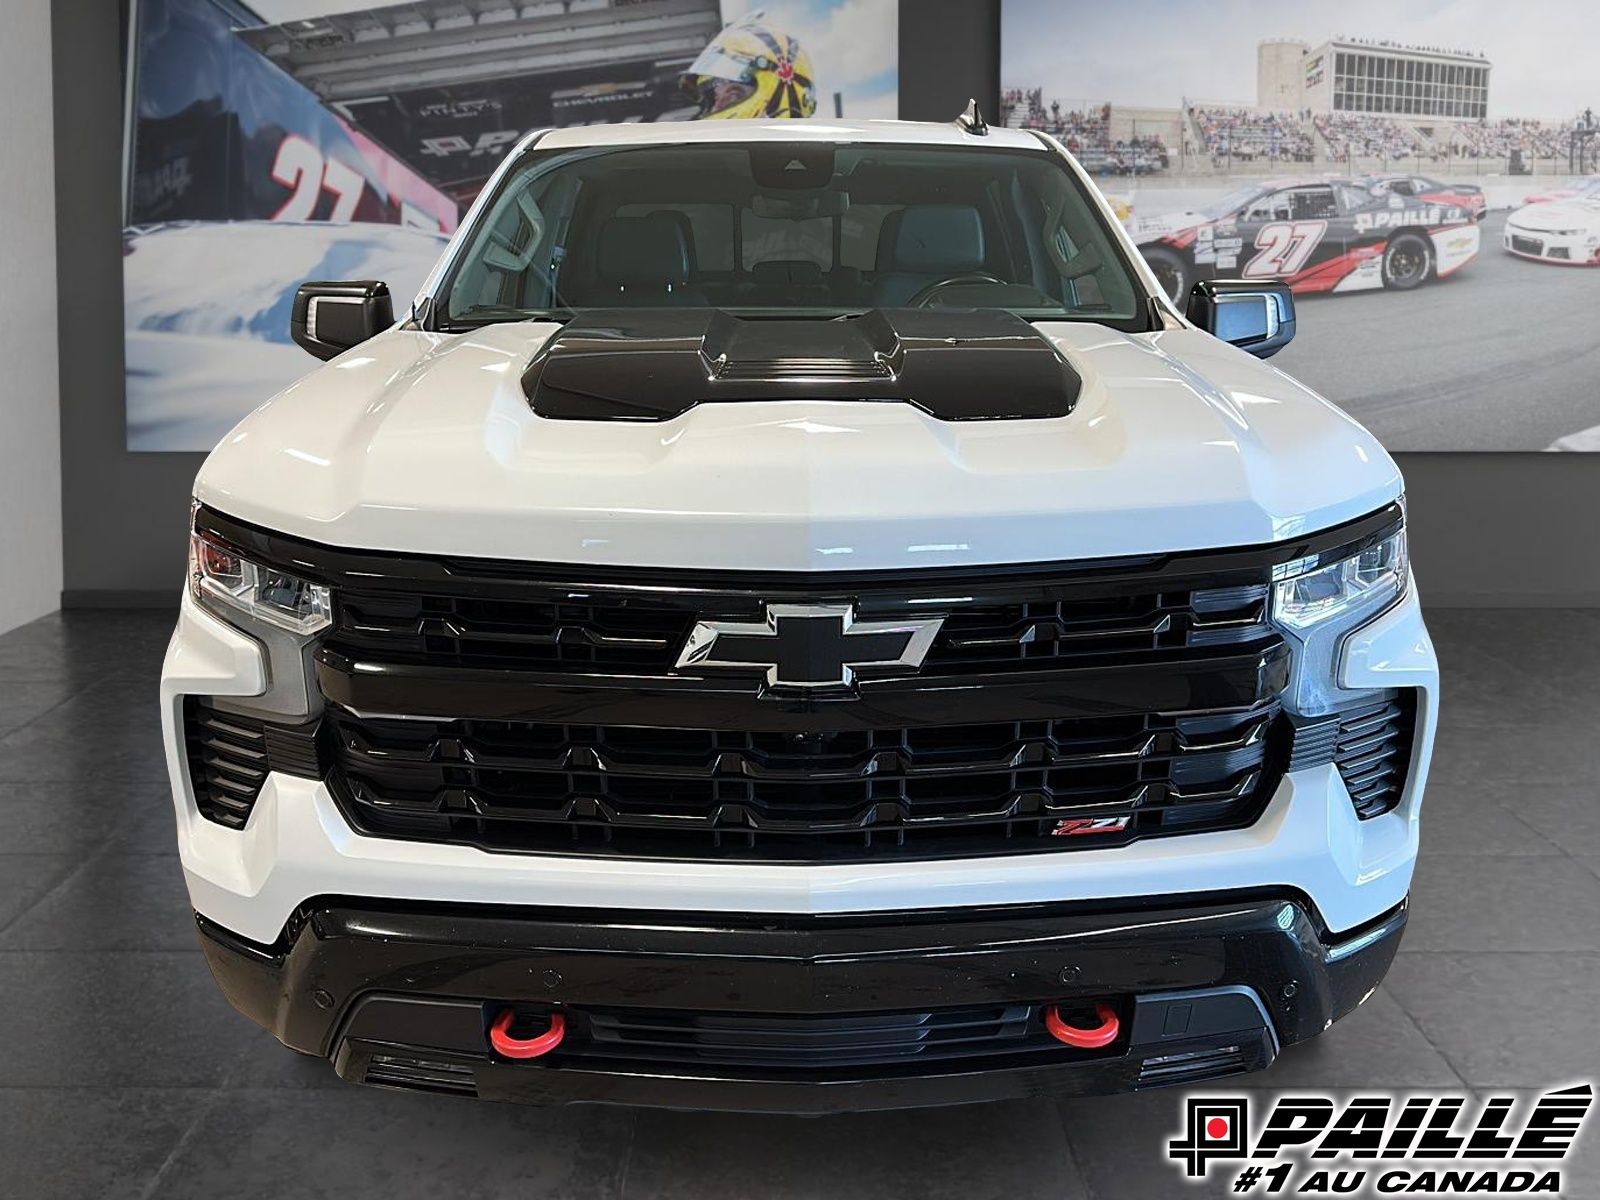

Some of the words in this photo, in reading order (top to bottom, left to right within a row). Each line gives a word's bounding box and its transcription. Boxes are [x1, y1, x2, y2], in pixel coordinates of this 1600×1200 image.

[271, 134, 365, 223] 27
[1242, 220, 1328, 279] 27
[1051, 816, 1131, 836] Z71
